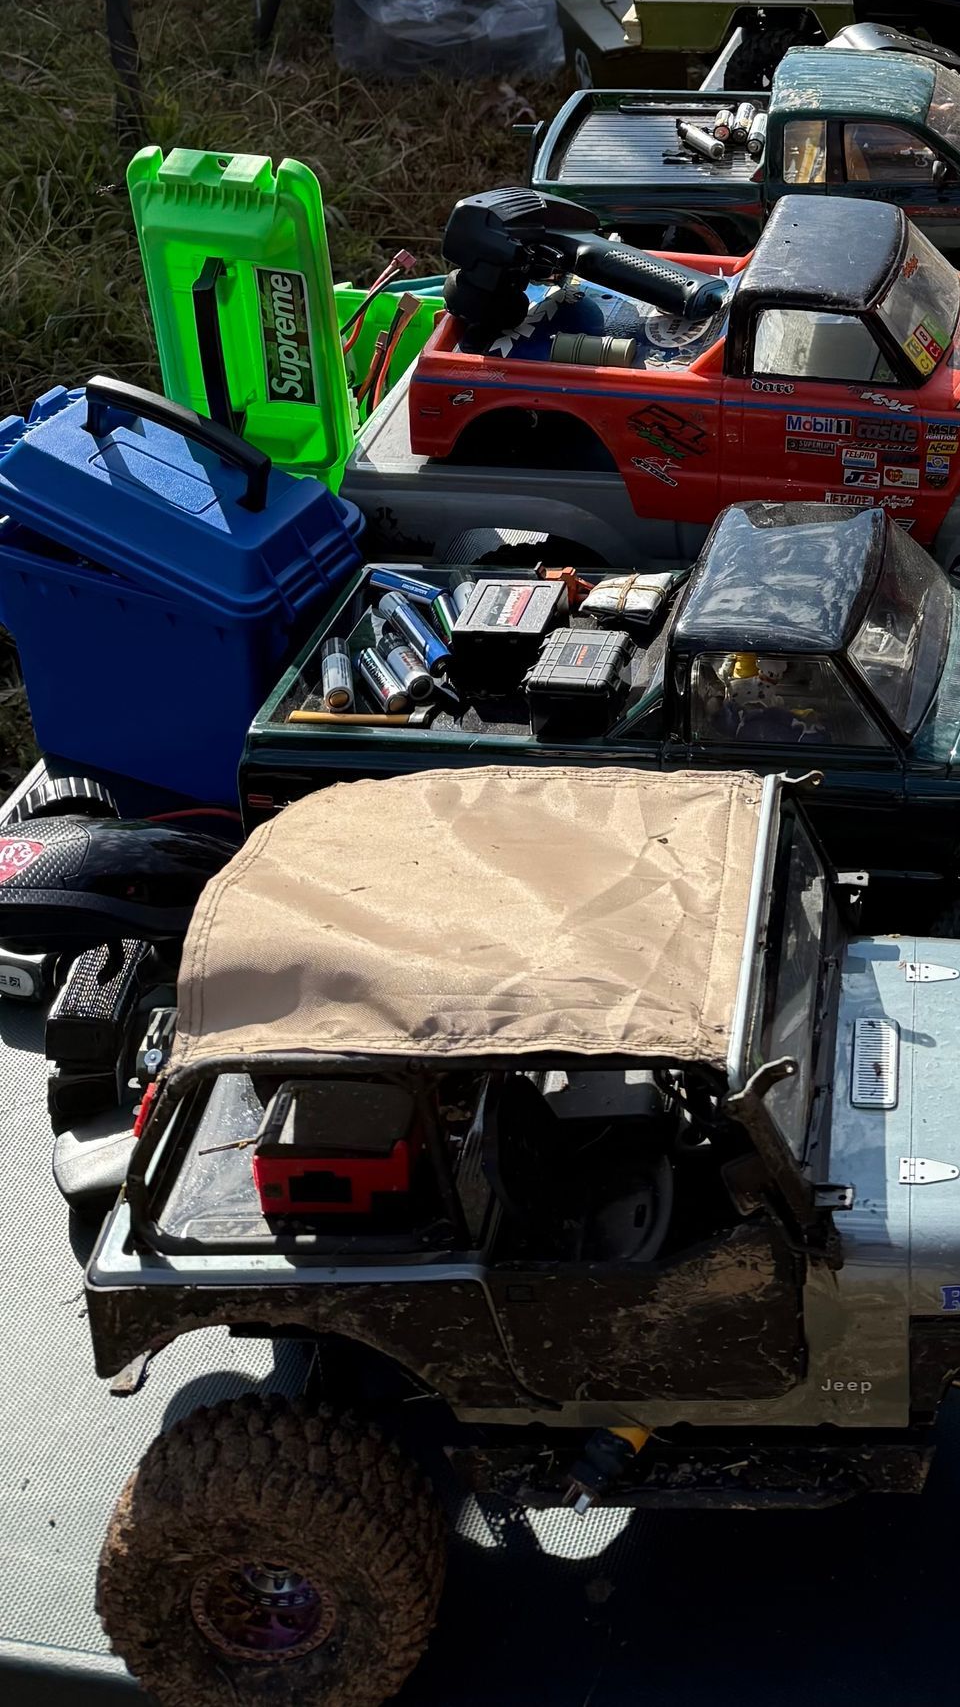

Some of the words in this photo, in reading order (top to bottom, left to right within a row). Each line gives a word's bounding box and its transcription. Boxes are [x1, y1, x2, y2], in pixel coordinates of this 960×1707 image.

[270, 273, 311, 399] Supreme
[787, 415, 833, 433] Mobil
[856, 422, 918, 443] castle
[821, 1378, 872, 1395] Jeep
